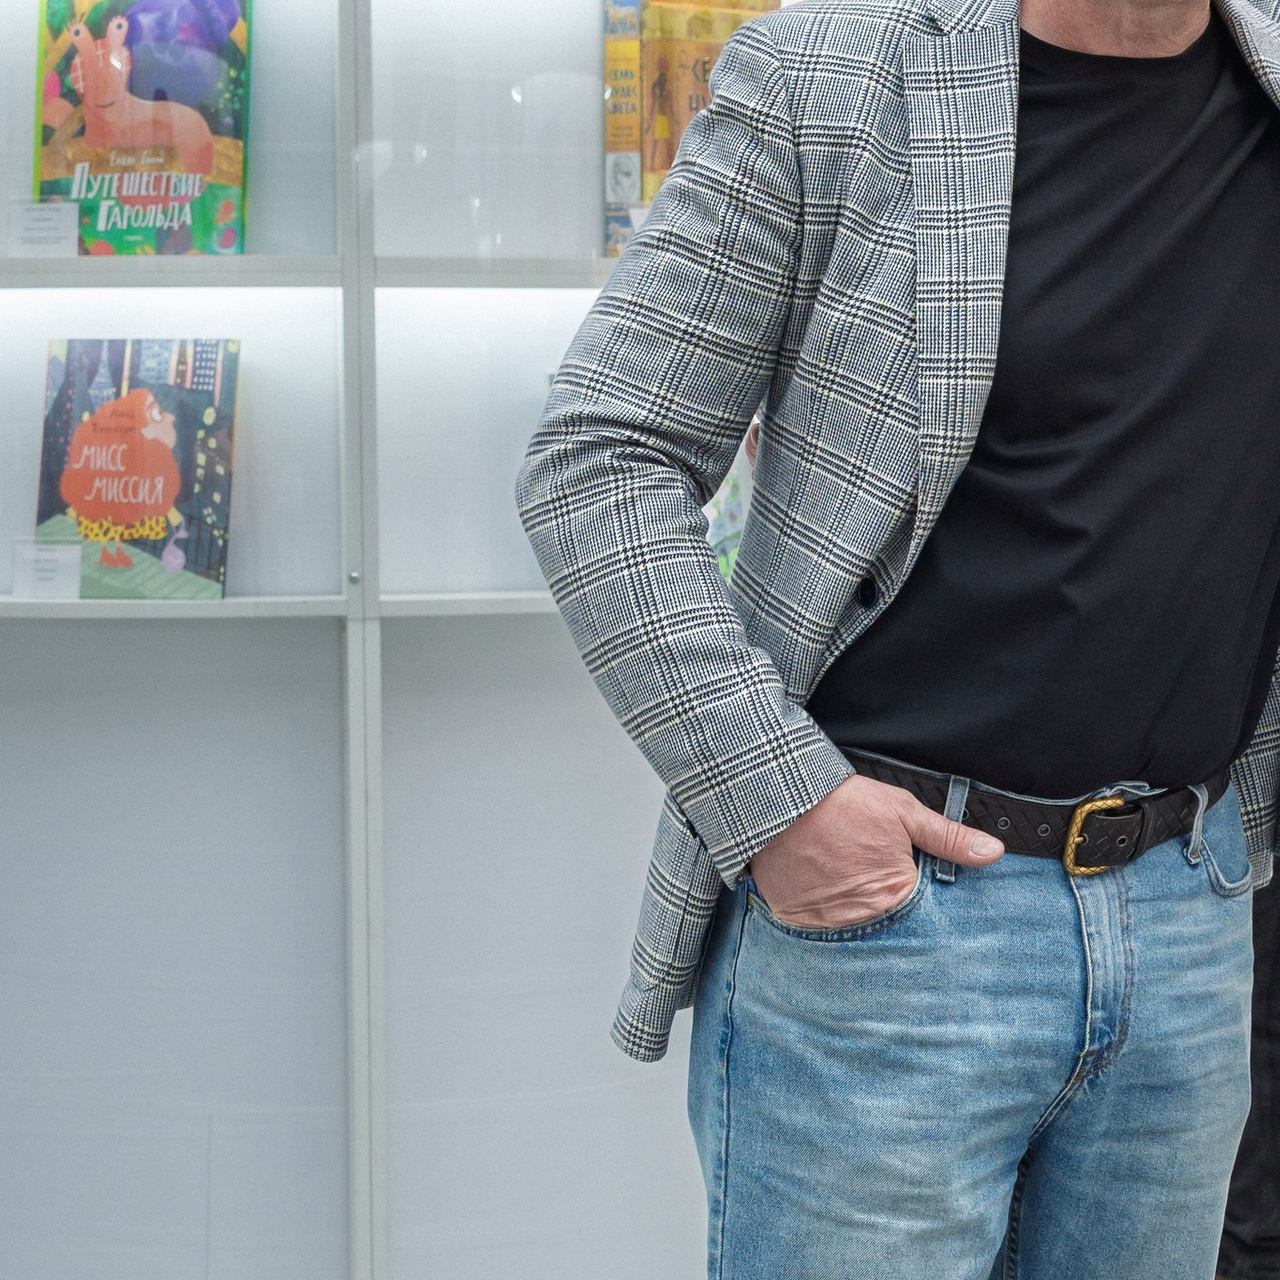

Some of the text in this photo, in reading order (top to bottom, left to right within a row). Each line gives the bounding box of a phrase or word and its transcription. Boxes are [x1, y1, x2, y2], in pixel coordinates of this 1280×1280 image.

[71, 161, 204, 200] ПУТЕШЕСТВИЕ
[97, 200, 193, 232] ГАРОЛЬДА
[72, 444, 128, 472] МИСС
[84, 475, 165, 505] МИССИЯ
